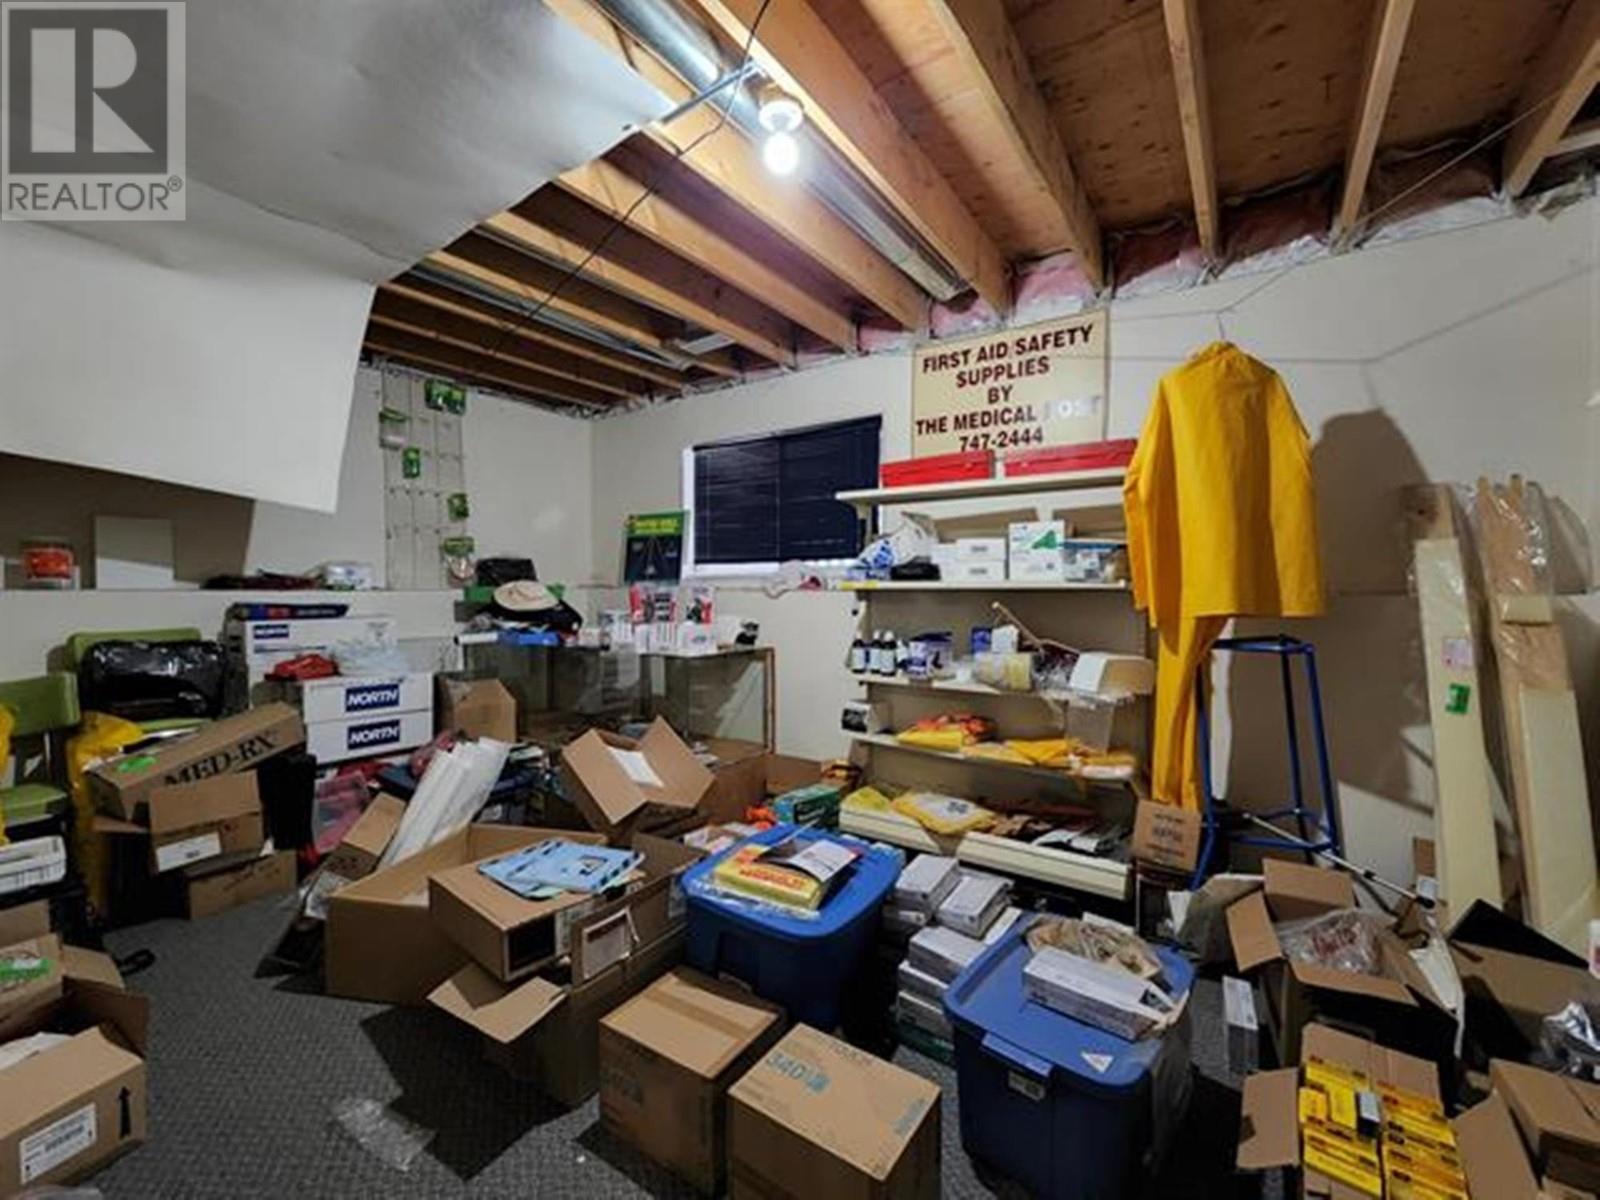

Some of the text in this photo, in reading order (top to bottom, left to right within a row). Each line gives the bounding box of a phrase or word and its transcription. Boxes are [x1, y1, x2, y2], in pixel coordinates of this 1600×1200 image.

[923, 324, 1093, 373] FIRST AID SAFETY
[956, 356, 1050, 388] SUPPLIES
[988, 385, 1013, 404] BY
[916, 416, 948, 435] THE
[953, 405, 1037, 431] MEDICAL
[959, 427, 1044, 452] 747-2444
[347, 688, 399, 707] NORTH
[350, 725, 400, 745] NORTH
[164, 734, 277, 786] MED-RX
